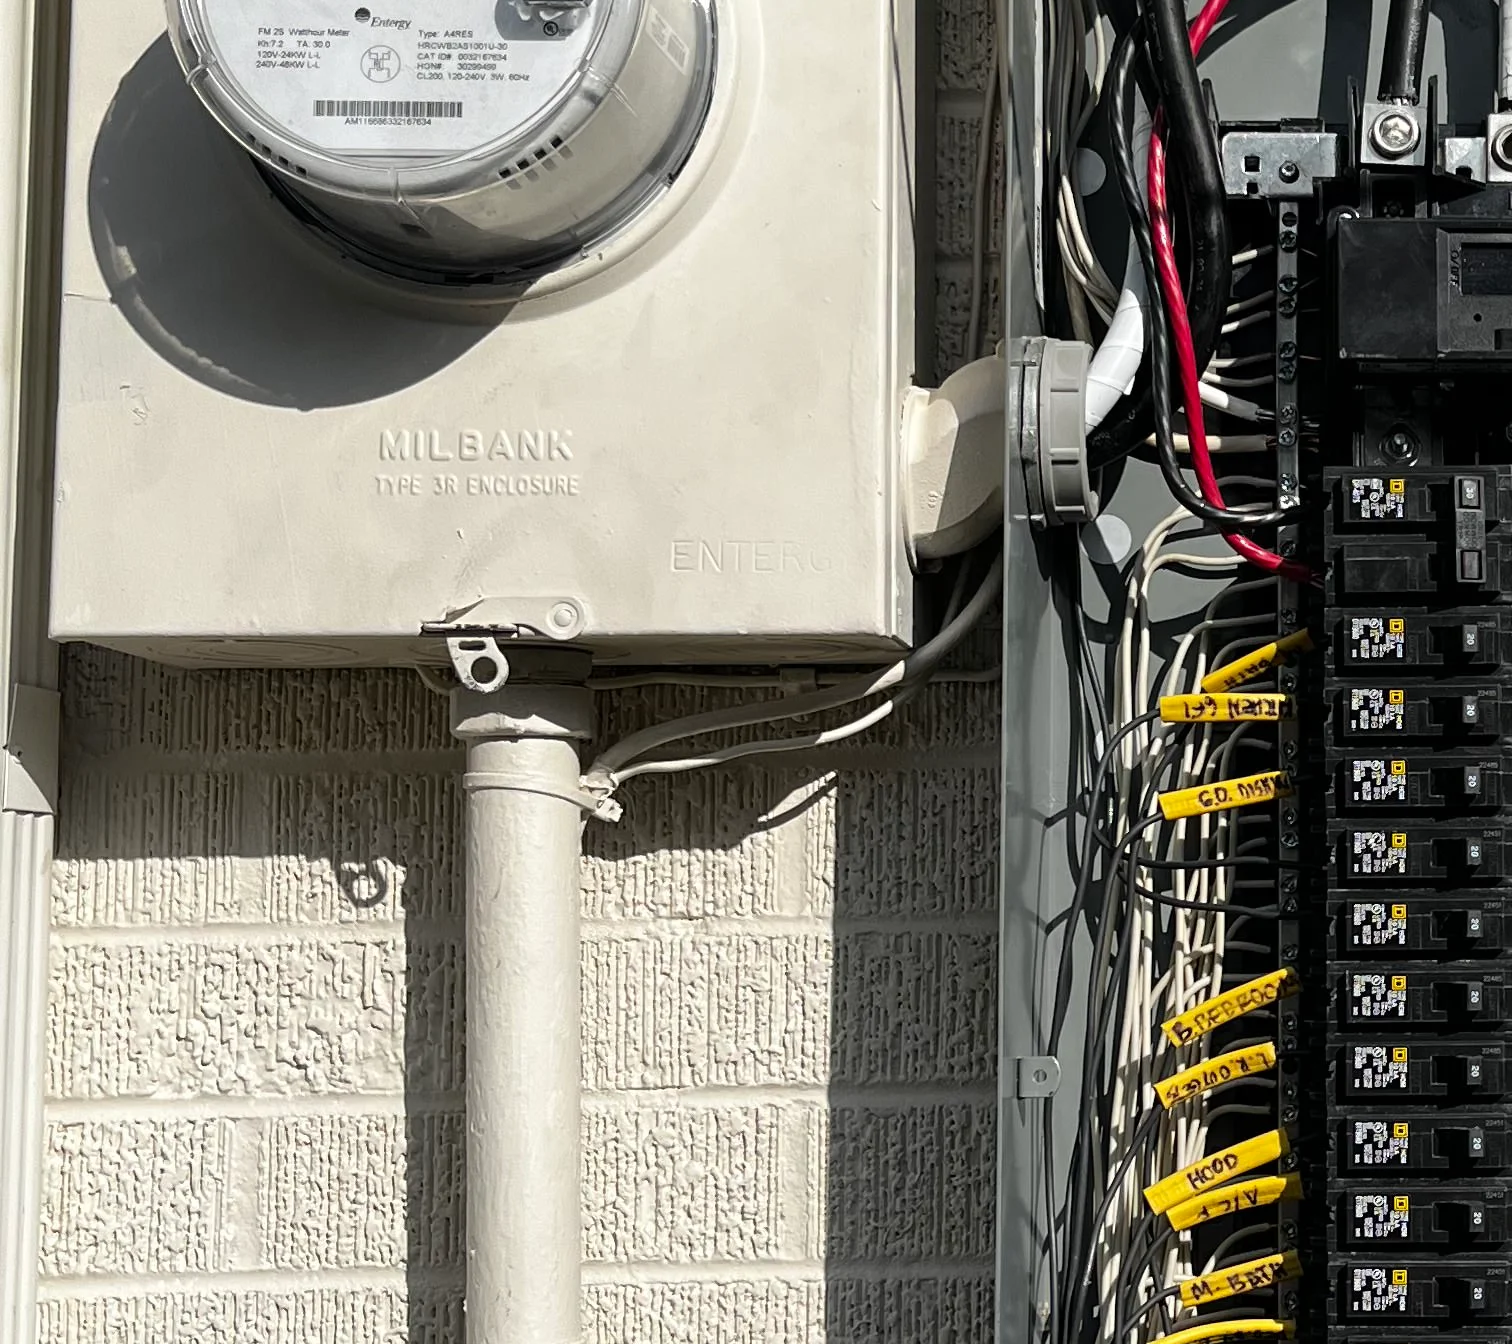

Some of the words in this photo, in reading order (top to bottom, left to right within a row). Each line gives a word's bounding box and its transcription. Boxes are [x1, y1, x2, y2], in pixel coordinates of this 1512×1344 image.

[371, 16, 412, 30] Entergy
[258, 28, 271, 36] FM
[288, 28, 325, 36] Watthour
[328, 29, 350, 37] Meter
[438, 53, 452, 61] ID#
[380, 429, 575, 462] MILBANK
[376, 474, 422, 496] TYPE
[432, 474, 458, 495] 3R
[466, 474, 581, 495] ENCLOSURE
[1466, 633, 1475, 646] 20
[1466, 704, 1476, 717] 20
[1467, 775, 1477, 788] 20
[1470, 845, 1479, 858] 20
[1470, 918, 1480, 931] 20
[1470, 990, 1480, 1003] 20
[1471, 1065, 1480, 1078] 20
[1472, 1137, 1482, 1150] 20
[1186, 1153, 1238, 1190] HOOD
[1473, 1211, 1482, 1225] 20
[1473, 1287, 1483, 1300] 20
